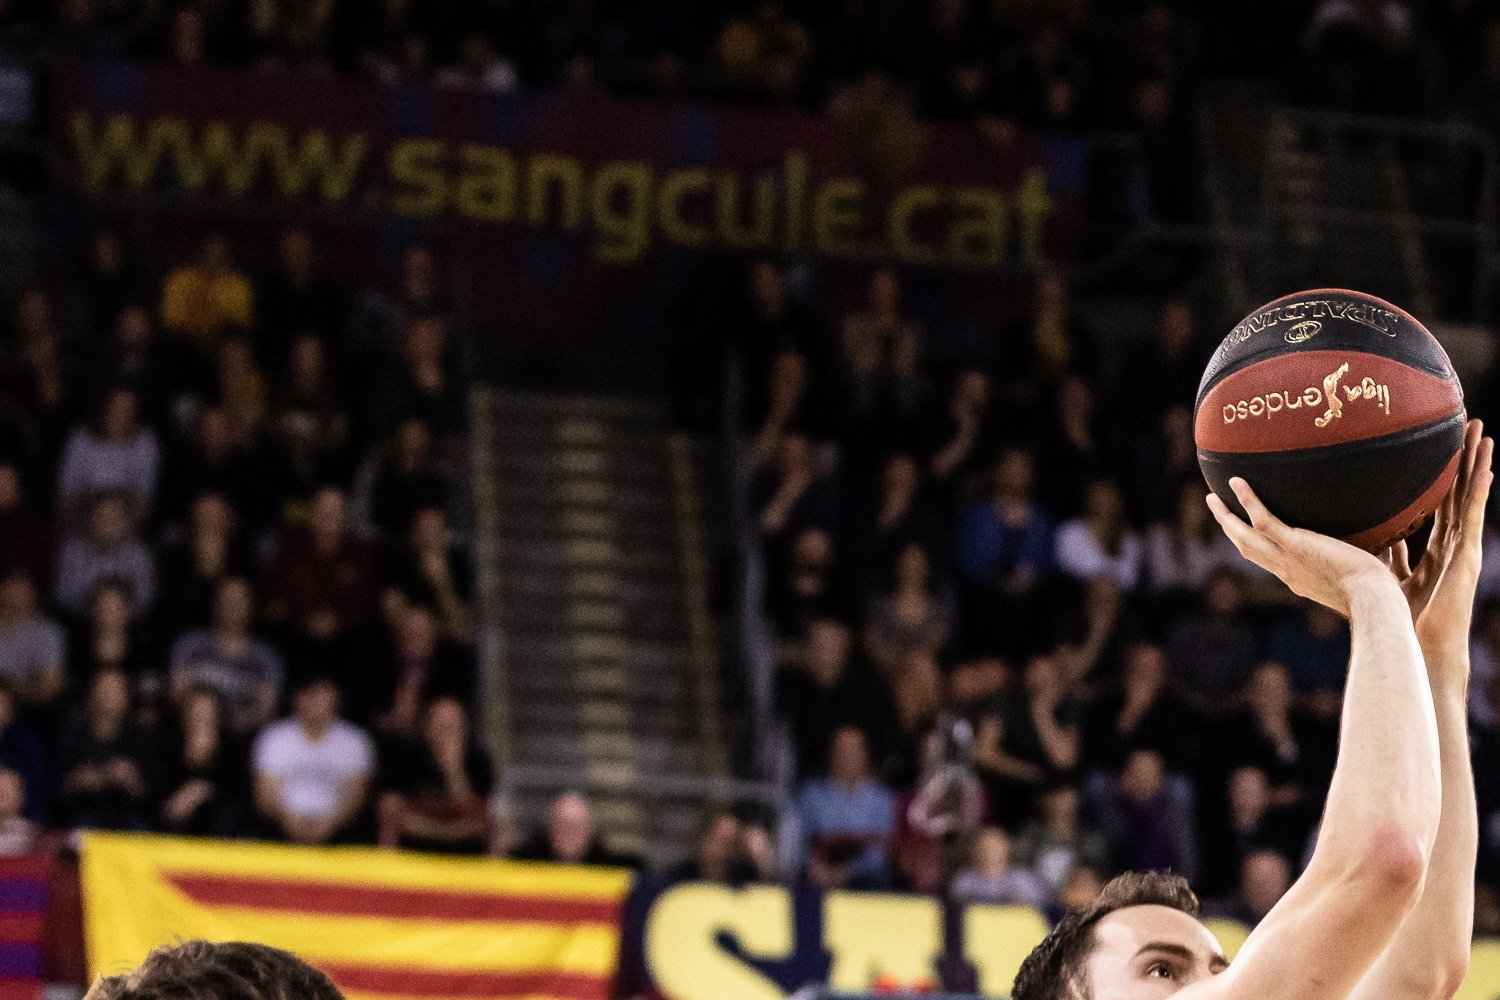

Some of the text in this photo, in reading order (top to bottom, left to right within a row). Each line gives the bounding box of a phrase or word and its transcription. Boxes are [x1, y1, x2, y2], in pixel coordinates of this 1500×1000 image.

[69, 111, 1053, 268] www.sangcule.cat
[1222, 377, 1390, 424] liga endesa
